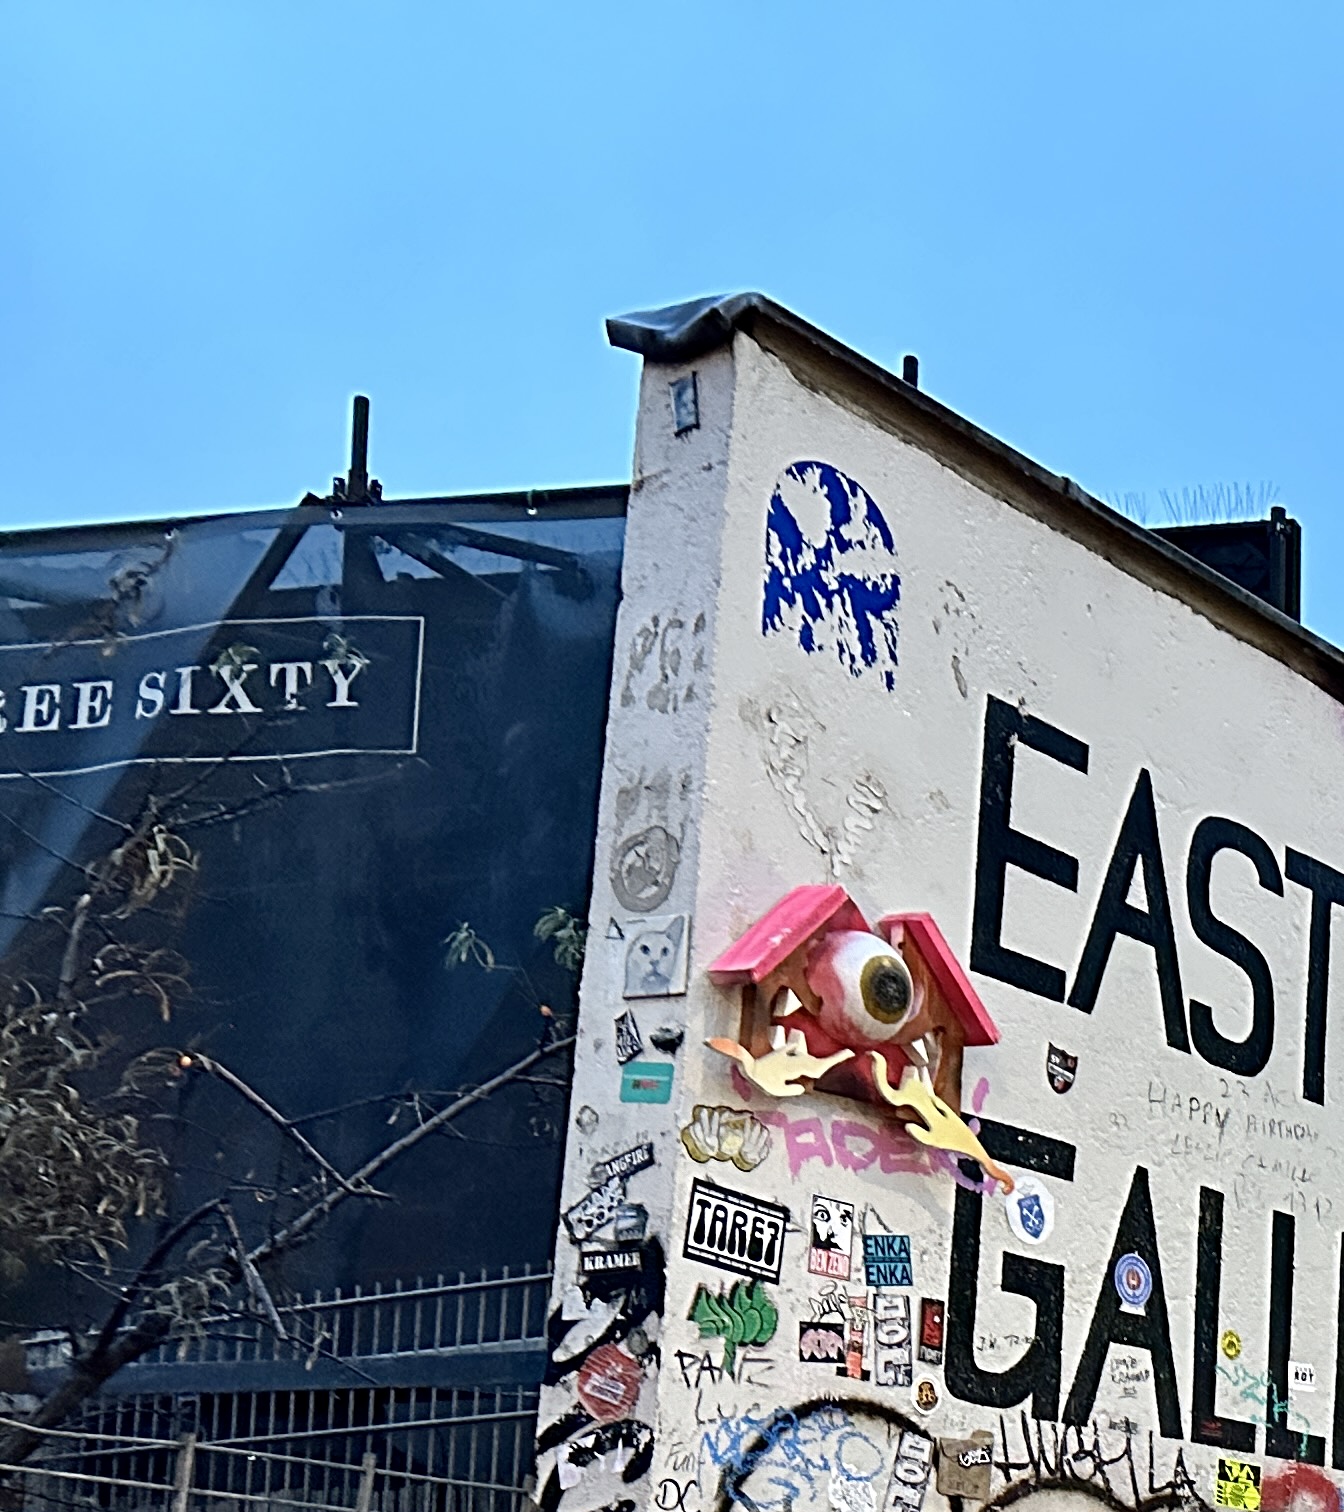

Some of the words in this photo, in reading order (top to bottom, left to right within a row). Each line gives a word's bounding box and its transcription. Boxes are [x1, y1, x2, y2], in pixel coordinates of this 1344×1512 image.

[136, 658, 370, 719] SIXTY
[865, 1236, 911, 1258] ENKA
[866, 1264, 913, 1285] ENKA
